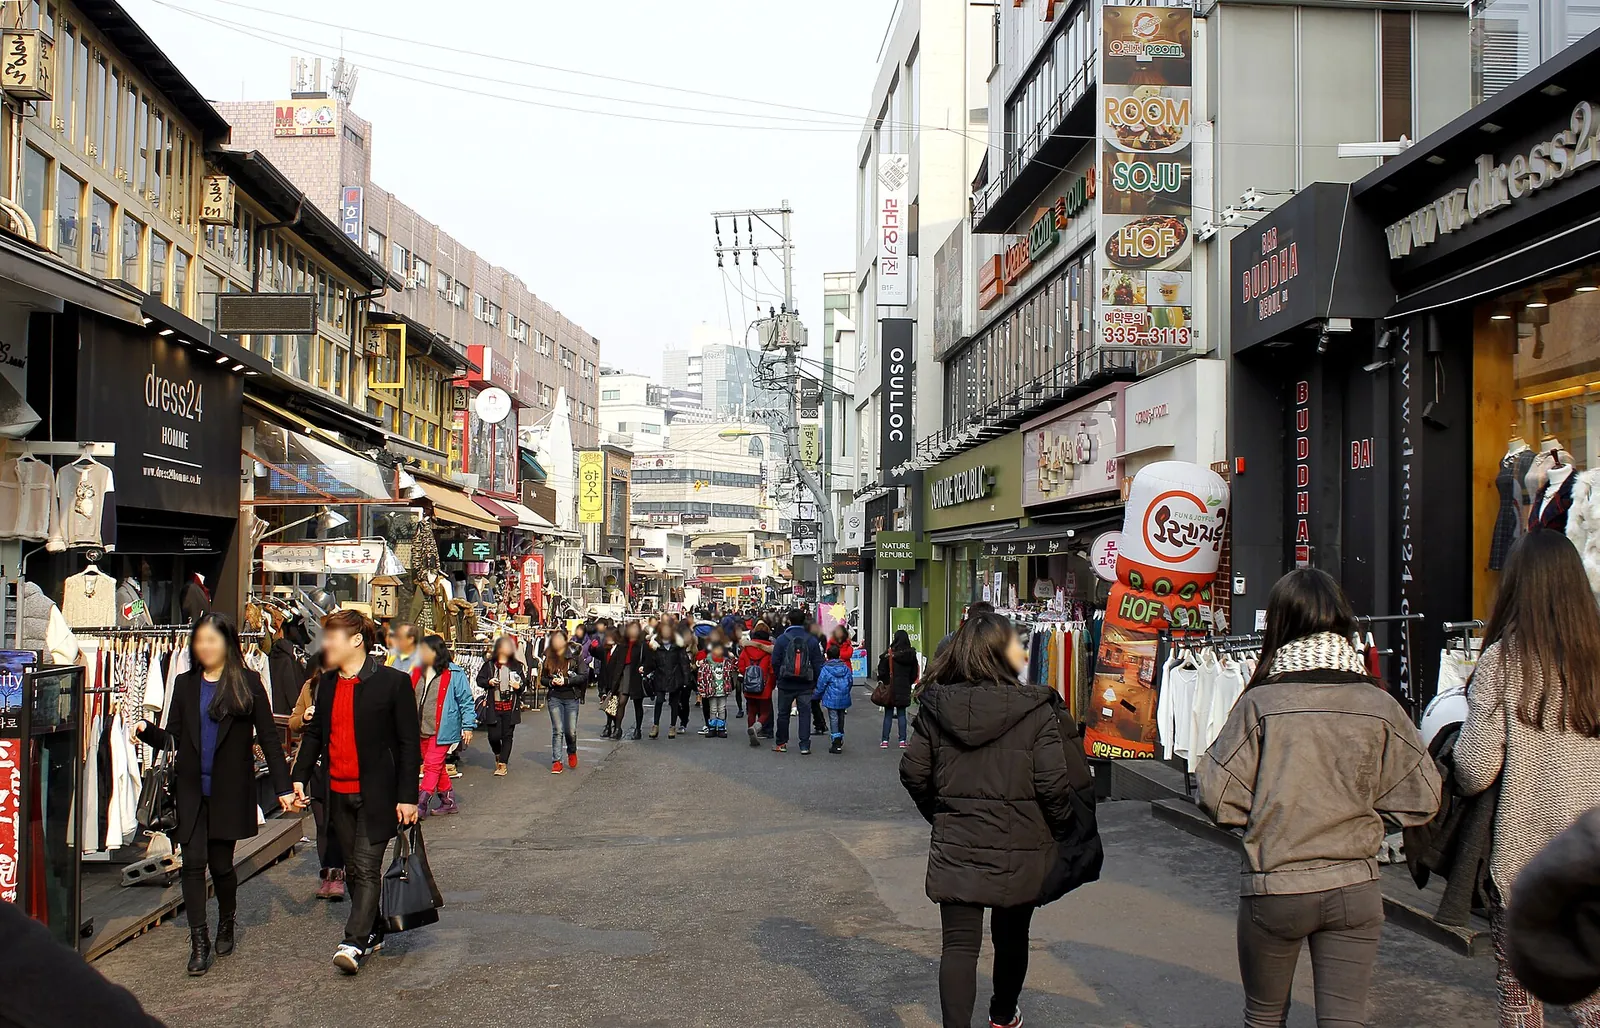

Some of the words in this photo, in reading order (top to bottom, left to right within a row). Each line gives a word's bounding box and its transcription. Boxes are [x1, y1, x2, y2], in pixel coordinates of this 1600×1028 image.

[1103, 96, 1190, 127] ROOM
[1112, 161, 1181, 192] SOJU
[1385, 100, 1600, 260] www.dress2
[345, 206, 358, 244] 호미
[882, 198, 899, 275] 라디오키친
[1262, 226, 1278, 255] BAR
[1119, 228, 1175, 257] HOF
[1242, 242, 1298, 304] BUDDHA
[1104, 312, 1145, 325] 예약문의
[1104, 326, 1189, 346] 335-3113
[145, 363, 203, 422] dress24
[889, 347, 904, 442] OSULLOC
[161, 426, 189, 450] HOMME
[805, 430, 813, 467] 맥주창고
[1351, 437, 1374, 470] BA
[1296, 380, 1309, 542] BUDDHA
[583, 469, 599, 503] 향수
[930, 472, 954, 510] NATURE
[954, 464, 987, 505] REPUBLIC
[447, 542, 490, 560] 사주
[879, 551, 913, 559] REPUBLIC
[1119, 595, 1163, 624] HOF
[0, 670, 23, 690] ity
